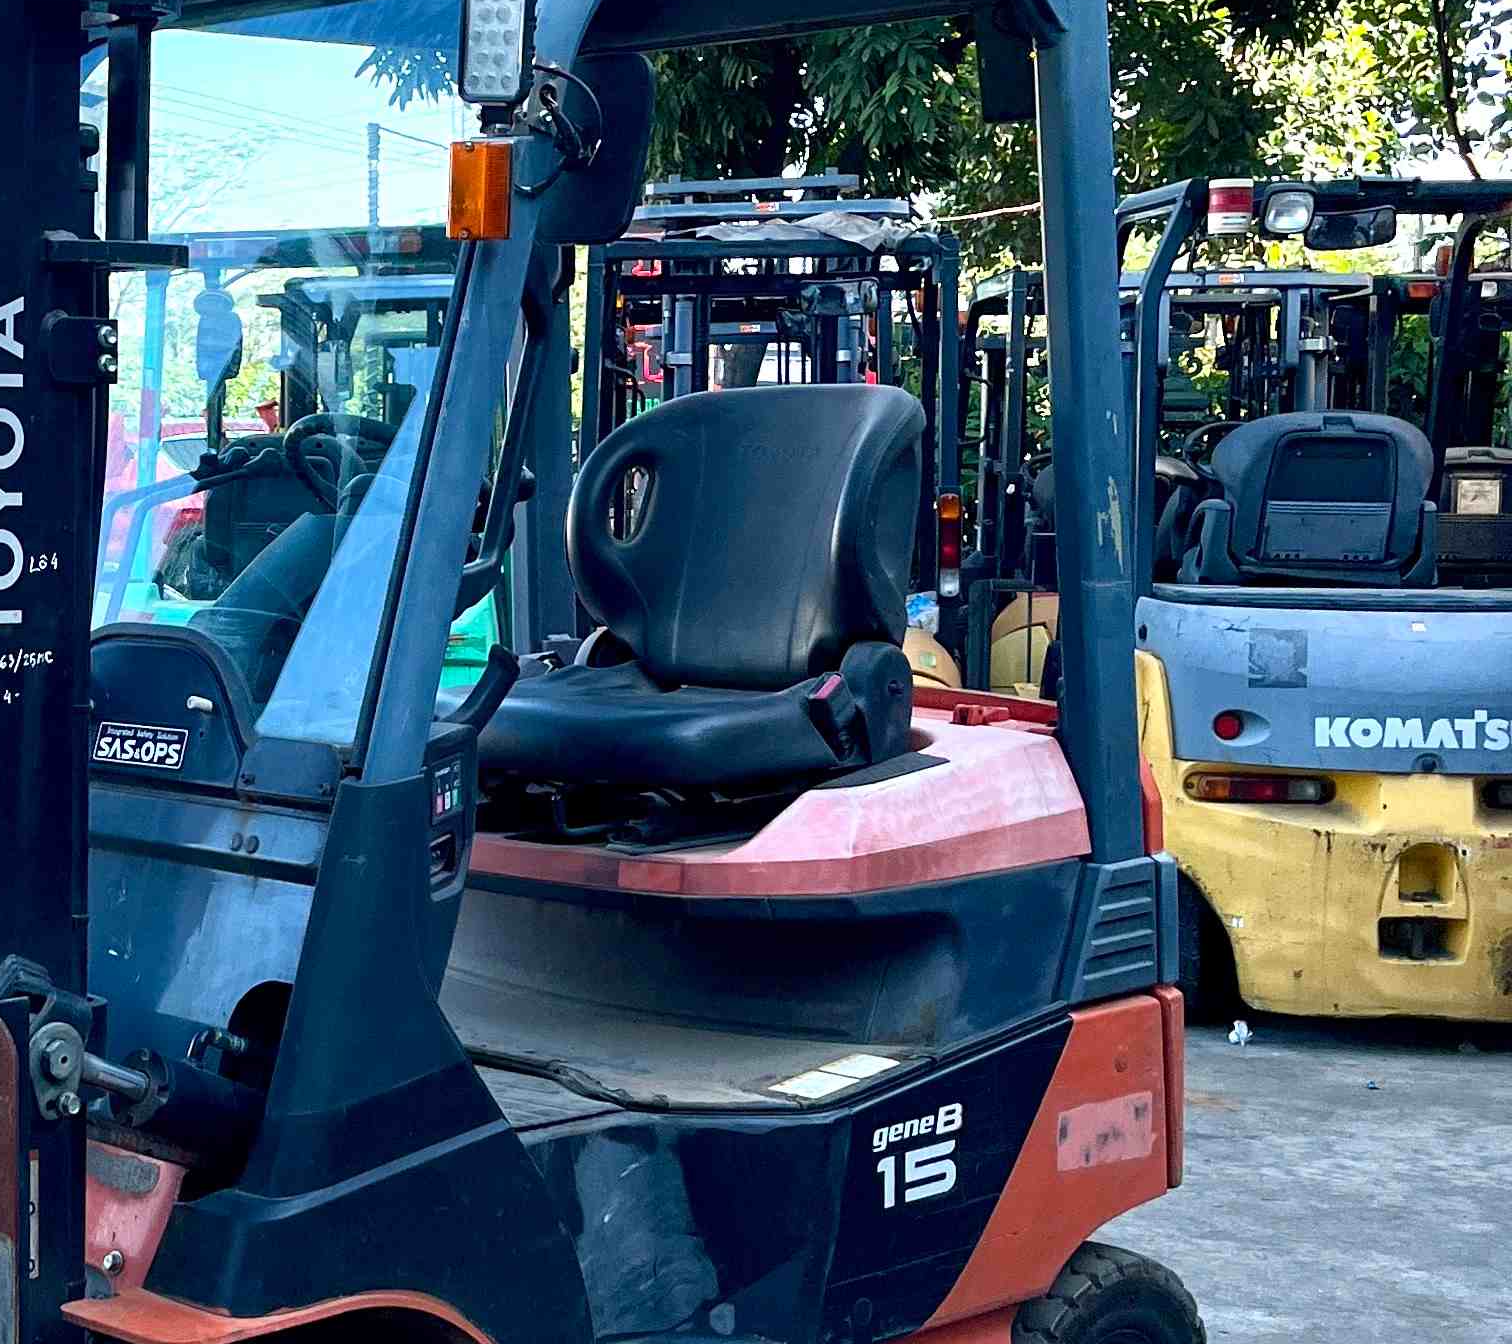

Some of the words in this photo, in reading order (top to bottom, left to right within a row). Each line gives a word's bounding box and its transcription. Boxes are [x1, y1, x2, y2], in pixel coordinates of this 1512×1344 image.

[50, 552, 59, 571] 4
[1314, 709, 1512, 751] KOMATS
[876, 1139, 957, 1209] 15
